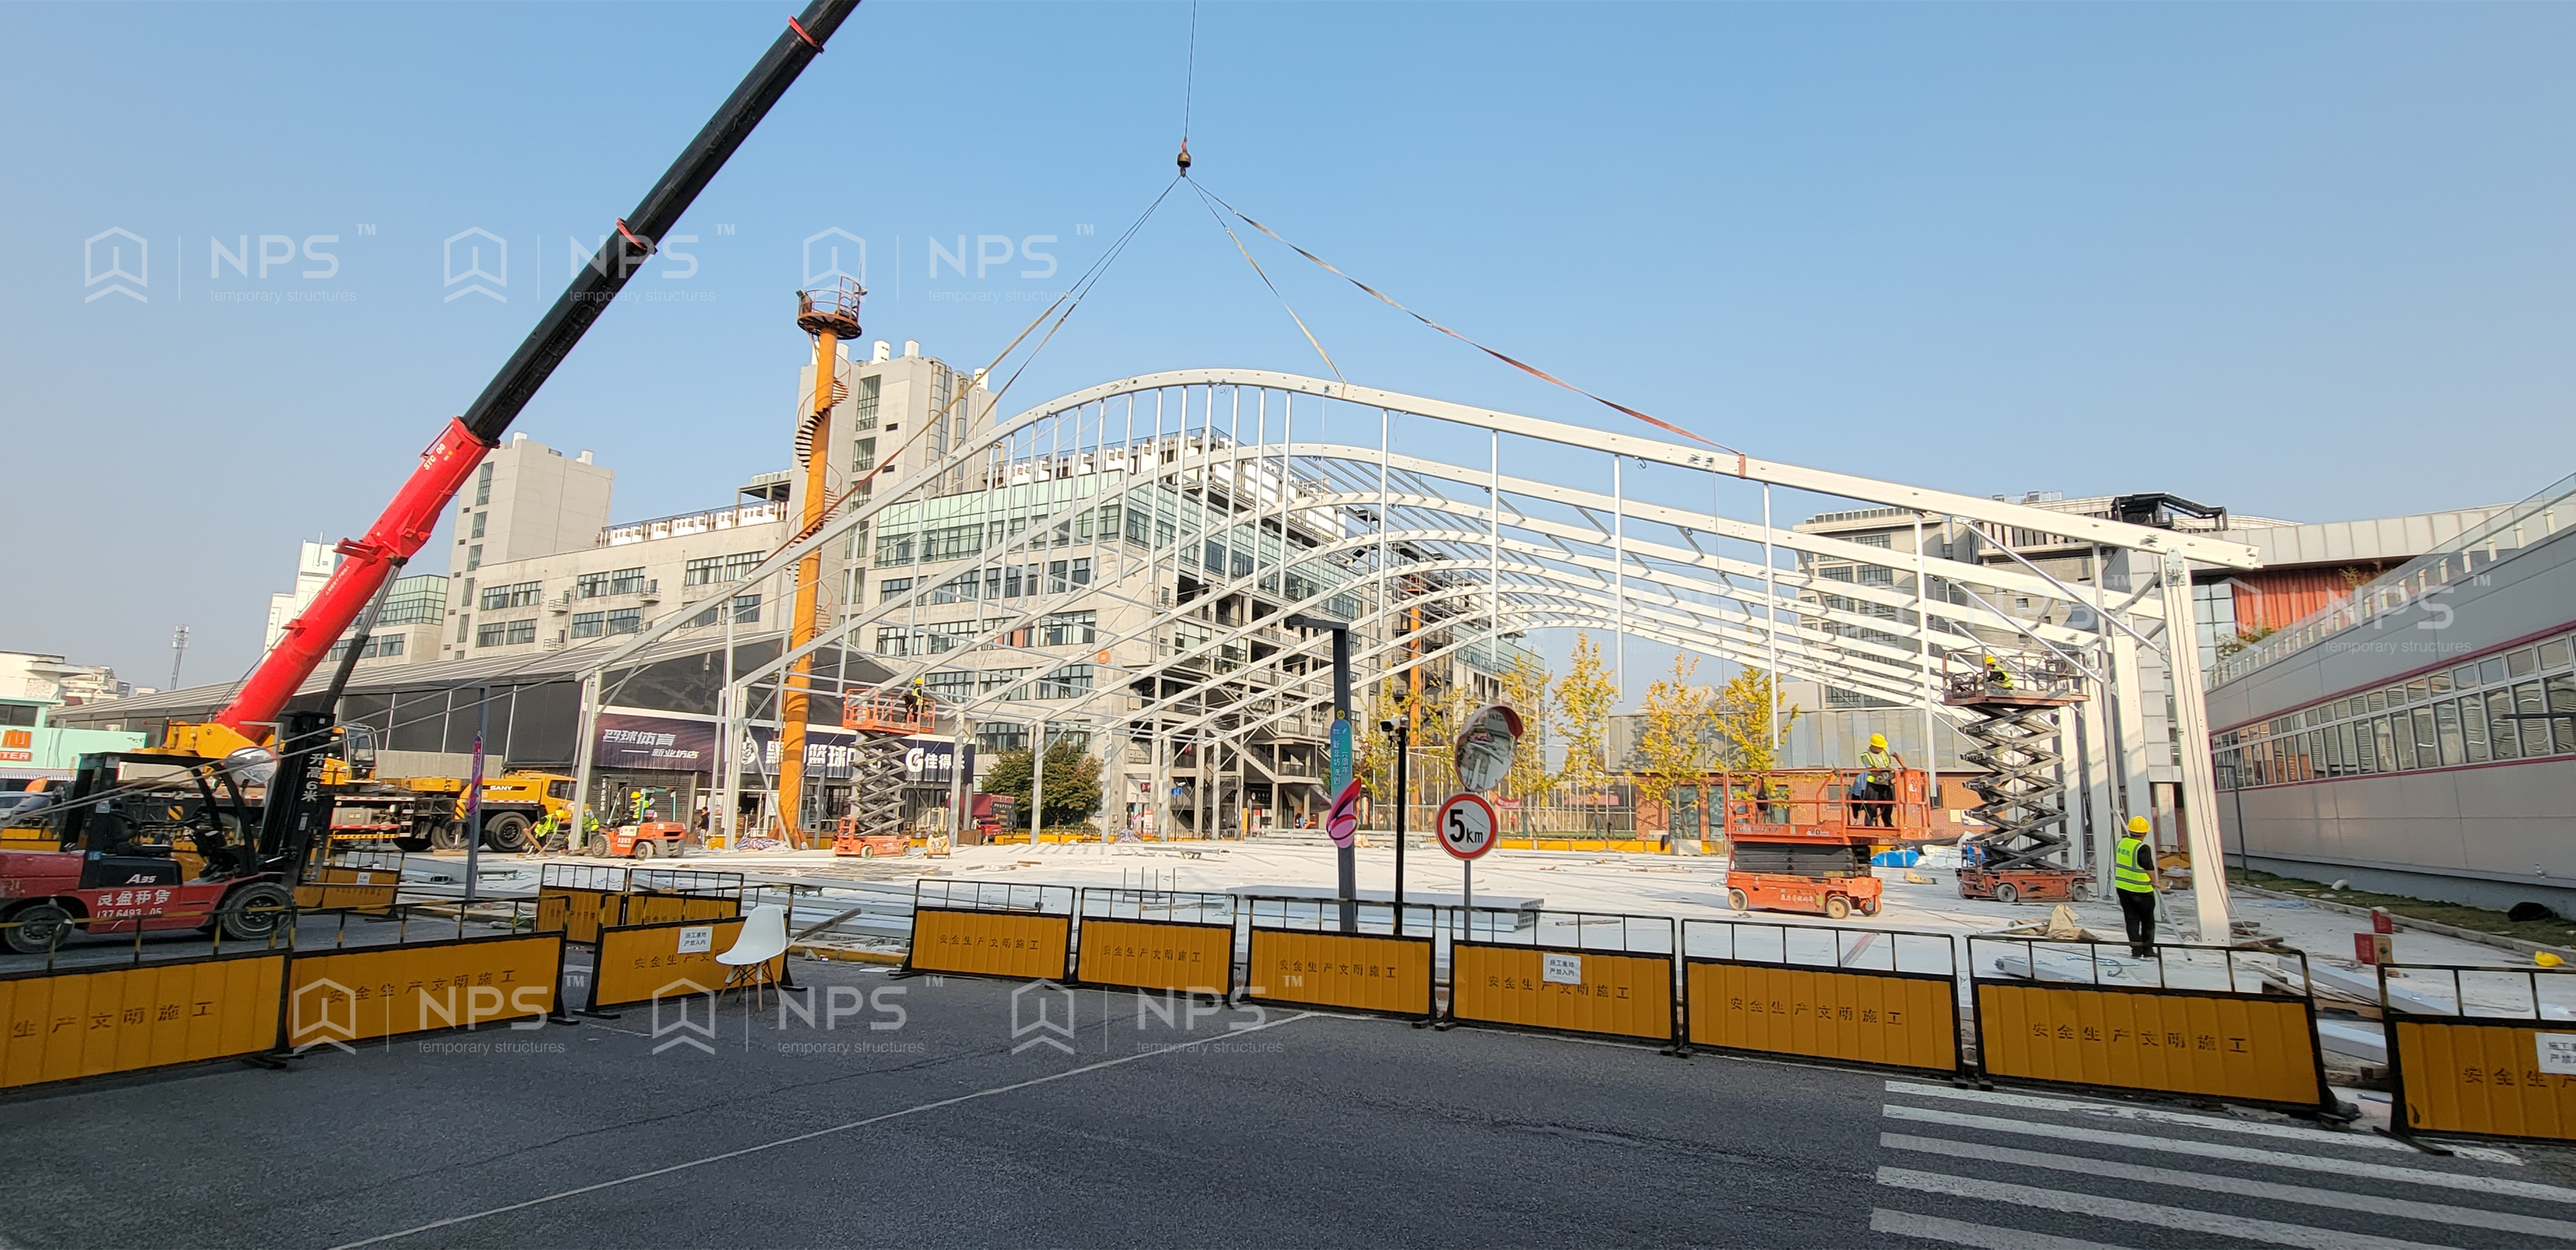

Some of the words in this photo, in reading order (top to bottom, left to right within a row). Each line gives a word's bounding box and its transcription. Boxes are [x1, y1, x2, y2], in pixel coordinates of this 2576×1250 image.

[126, 874, 157, 884] A35
[1730, 997, 1902, 1026] 安全生产文明施工
[2032, 1022, 2248, 1053] 安全生产文明施工
